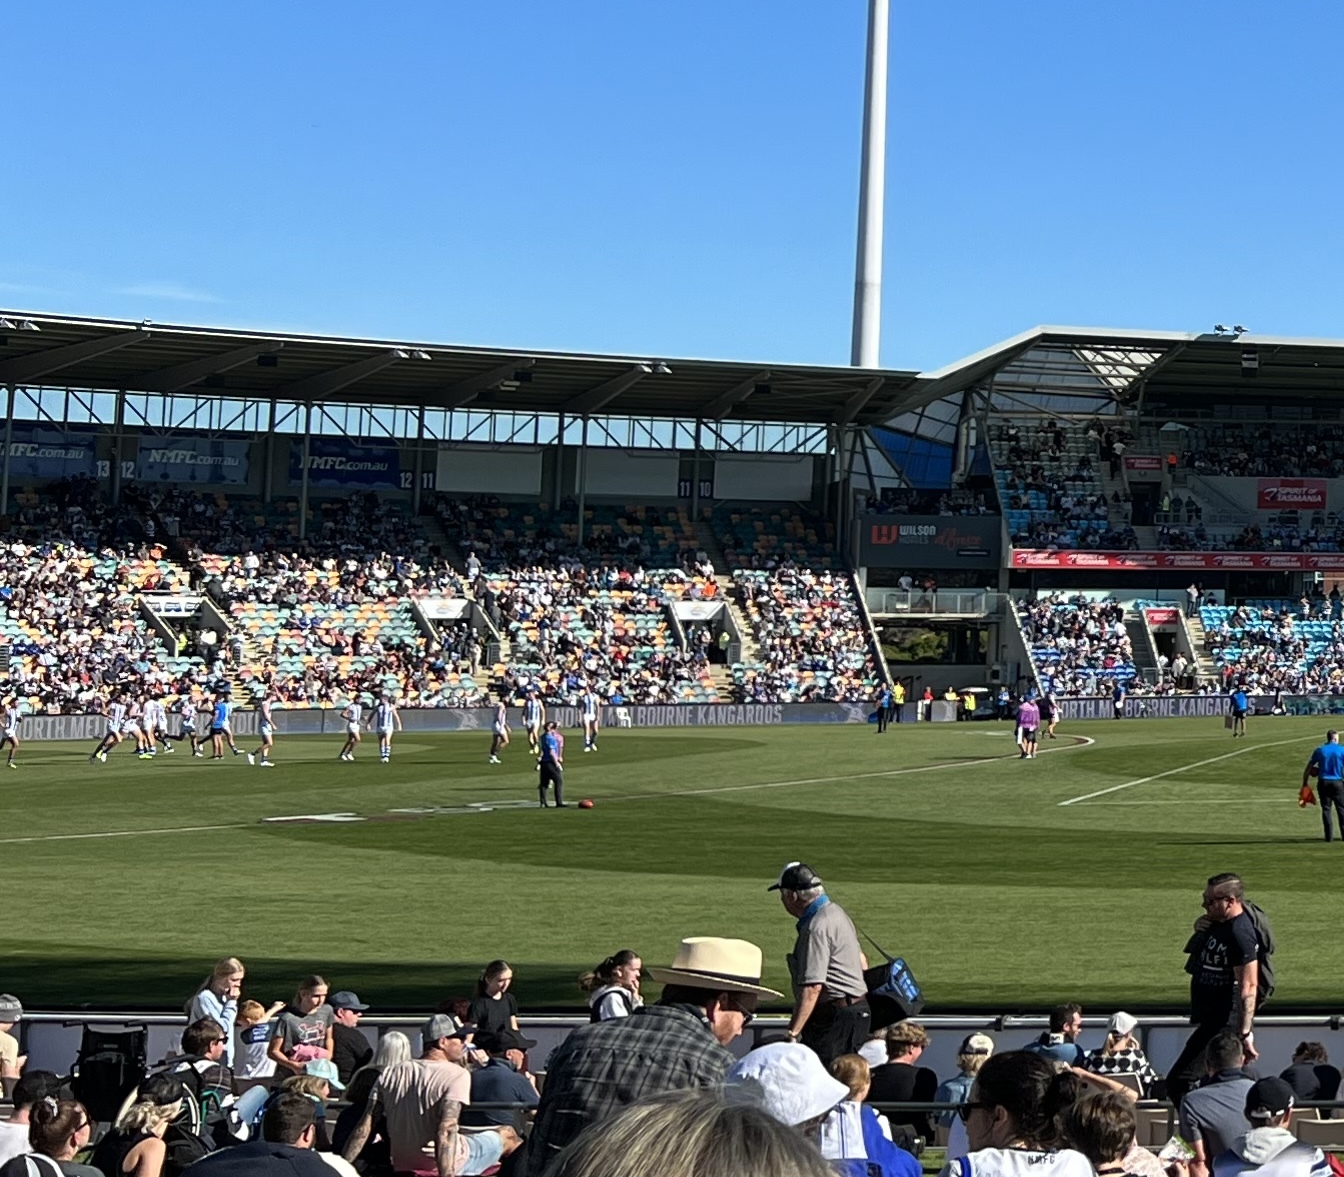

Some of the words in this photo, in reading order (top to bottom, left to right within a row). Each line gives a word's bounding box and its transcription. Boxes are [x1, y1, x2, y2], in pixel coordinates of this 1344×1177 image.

[96, 460, 110, 477] 13
[120, 461, 135, 478] 12
[400, 472, 413, 488] 12
[422, 472, 434, 488] 11
[680, 481, 690, 497] 11
[700, 481, 711, 497] 10
[1277, 494, 1322, 502] TASMANIA
[900, 525, 936, 535] WILSON
[697, 704, 783, 725] KANGAROOS
[1057, 700, 1095, 718] ORTH
[1179, 697, 1256, 716] KANGARS
